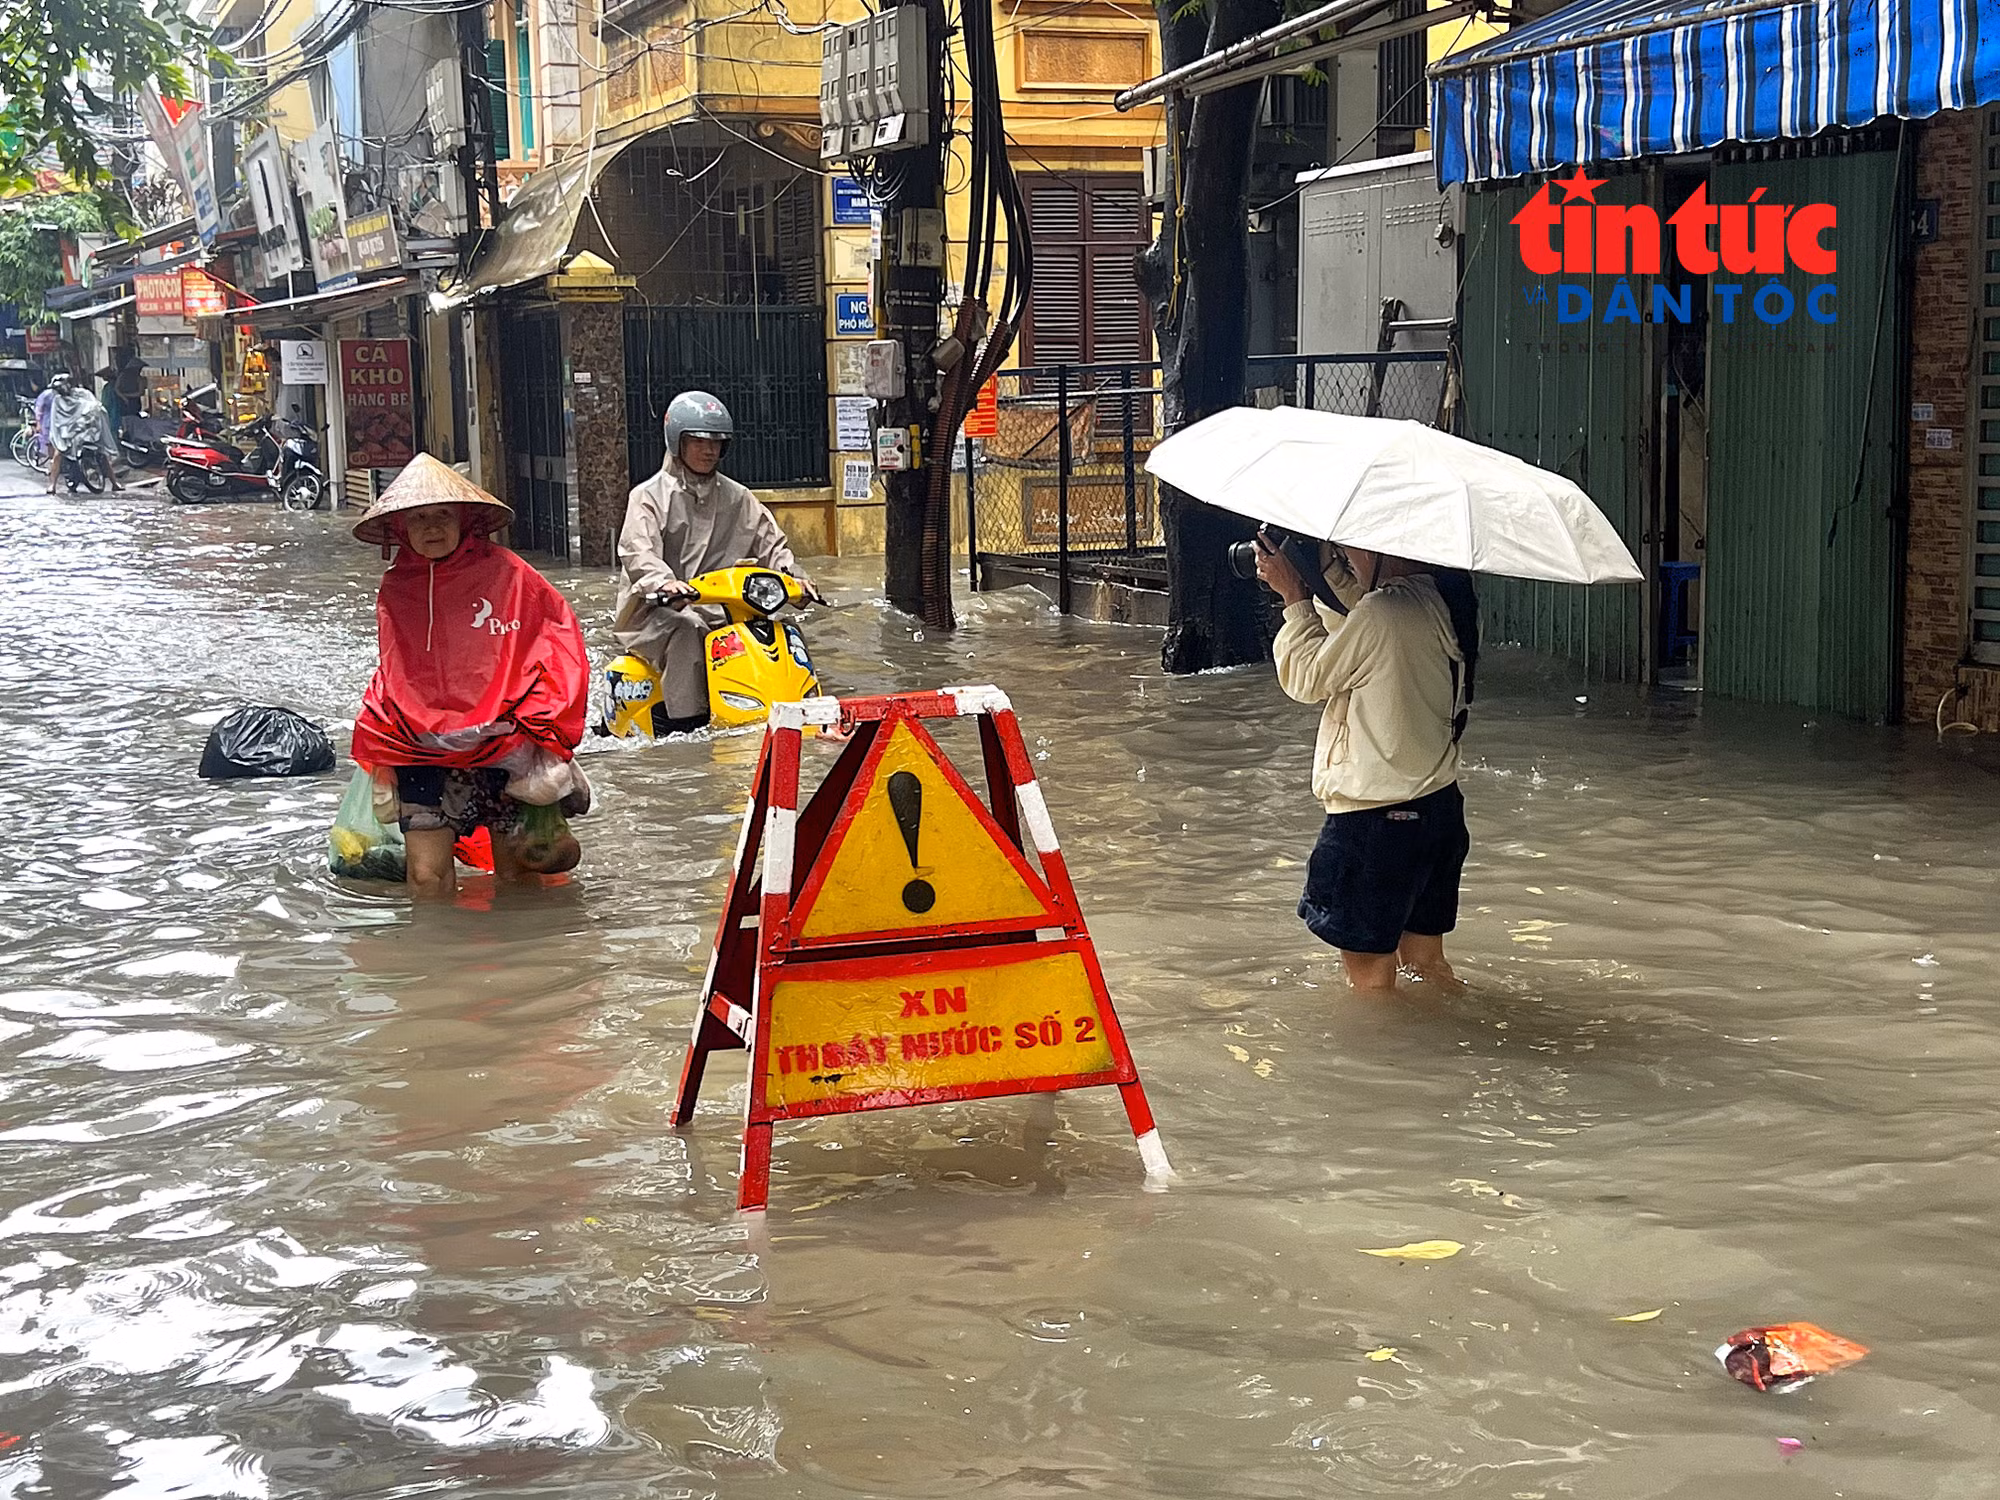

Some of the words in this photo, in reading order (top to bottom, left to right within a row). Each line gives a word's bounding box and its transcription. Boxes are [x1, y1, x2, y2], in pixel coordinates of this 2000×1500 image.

[850, 301, 867, 314] NG
[355, 342, 389, 363] CÁ
[350, 367, 404, 385] KHO
[347, 388, 385, 406] HÀNG
[488, 617, 521, 636] Pico
[899, 986, 968, 1018] XN
[775, 1033, 890, 1075] THOÁT
[900, 1020, 1003, 1062] NƯỚC
[1014, 1010, 1063, 1050] SỐ
[1074, 1016, 1097, 1044] 2
